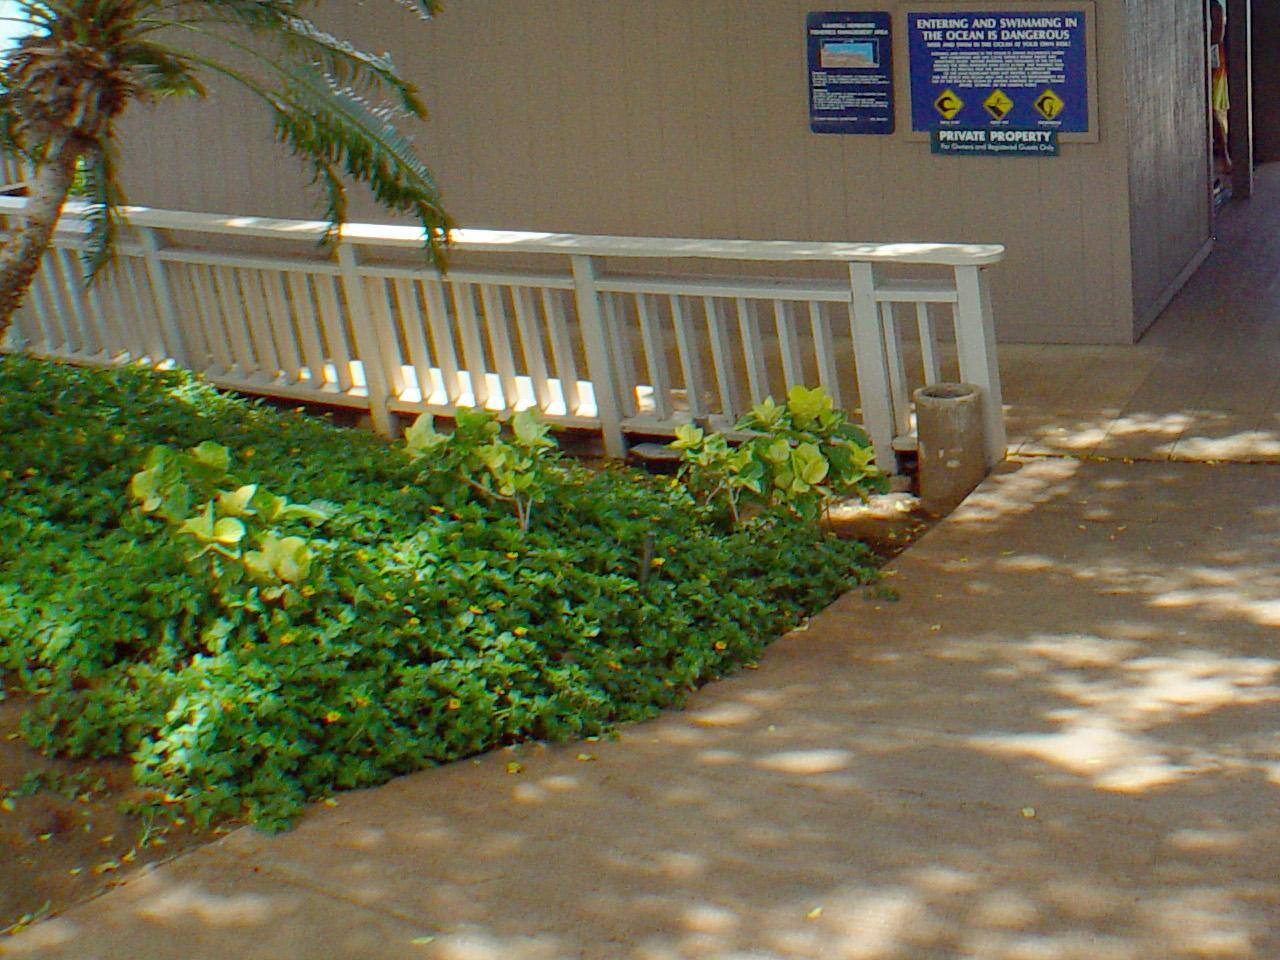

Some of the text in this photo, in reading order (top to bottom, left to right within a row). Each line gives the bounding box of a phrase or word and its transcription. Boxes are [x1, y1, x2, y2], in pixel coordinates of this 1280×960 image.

[916, 18, 1077, 29] ENTERING AND SWIMMING IN
[922, 30, 1070, 40] THE OCEAN IS DANGEROUS
[939, 131, 1051, 141] PRIVATE PROPERTY
